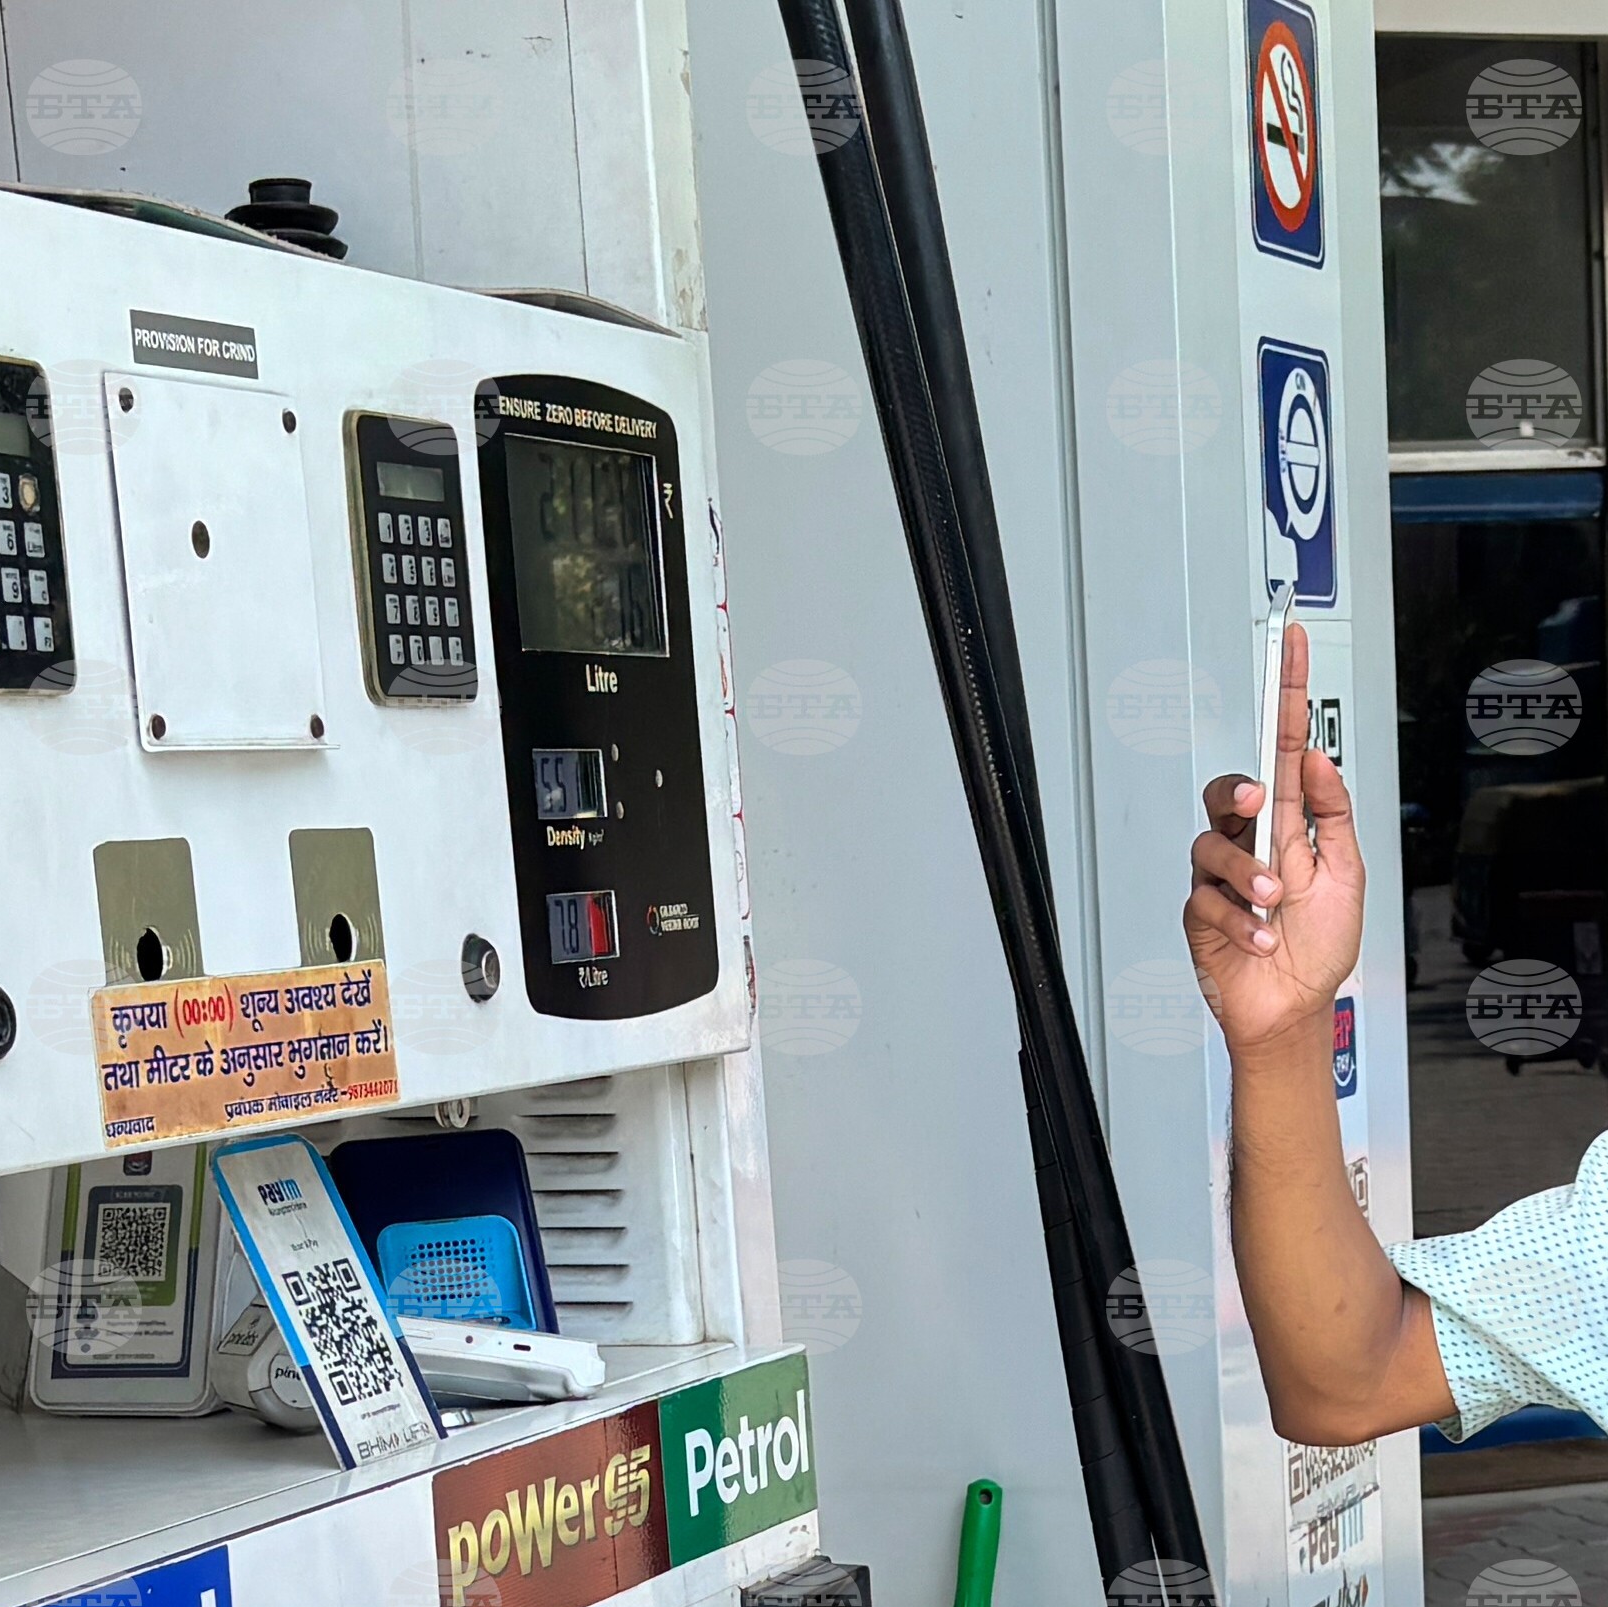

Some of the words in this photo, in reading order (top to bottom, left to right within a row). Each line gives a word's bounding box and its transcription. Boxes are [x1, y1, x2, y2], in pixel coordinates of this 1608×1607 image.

[134, 327, 194, 355] PROVISION
[197, 336, 221, 358] FOR
[499, 396, 542, 421] ENSURE
[545, 403, 573, 427] ZERO
[574, 407, 613, 433] BEFORE
[614, 414, 657, 439] DELIVERY
[586, 664, 618, 694] Litre
[547, 825, 586, 850] Density
[110, 1001, 167, 1049] कृपया
[174, 984, 234, 1038] (00:00)
[240, 989, 279, 1033] शून्य
[284, 984, 335, 1014] अवश्य
[339, 968, 372, 1008] देखें
[102, 1060, 139, 1092] तथा
[143, 1044, 192, 1084] मीटर
[195, 1040, 215, 1078] के
[219, 1042, 285, 1087] अनुसार
[258, 1177, 303, 1206] paytm
[685, 1389, 810, 1518] Petrol
